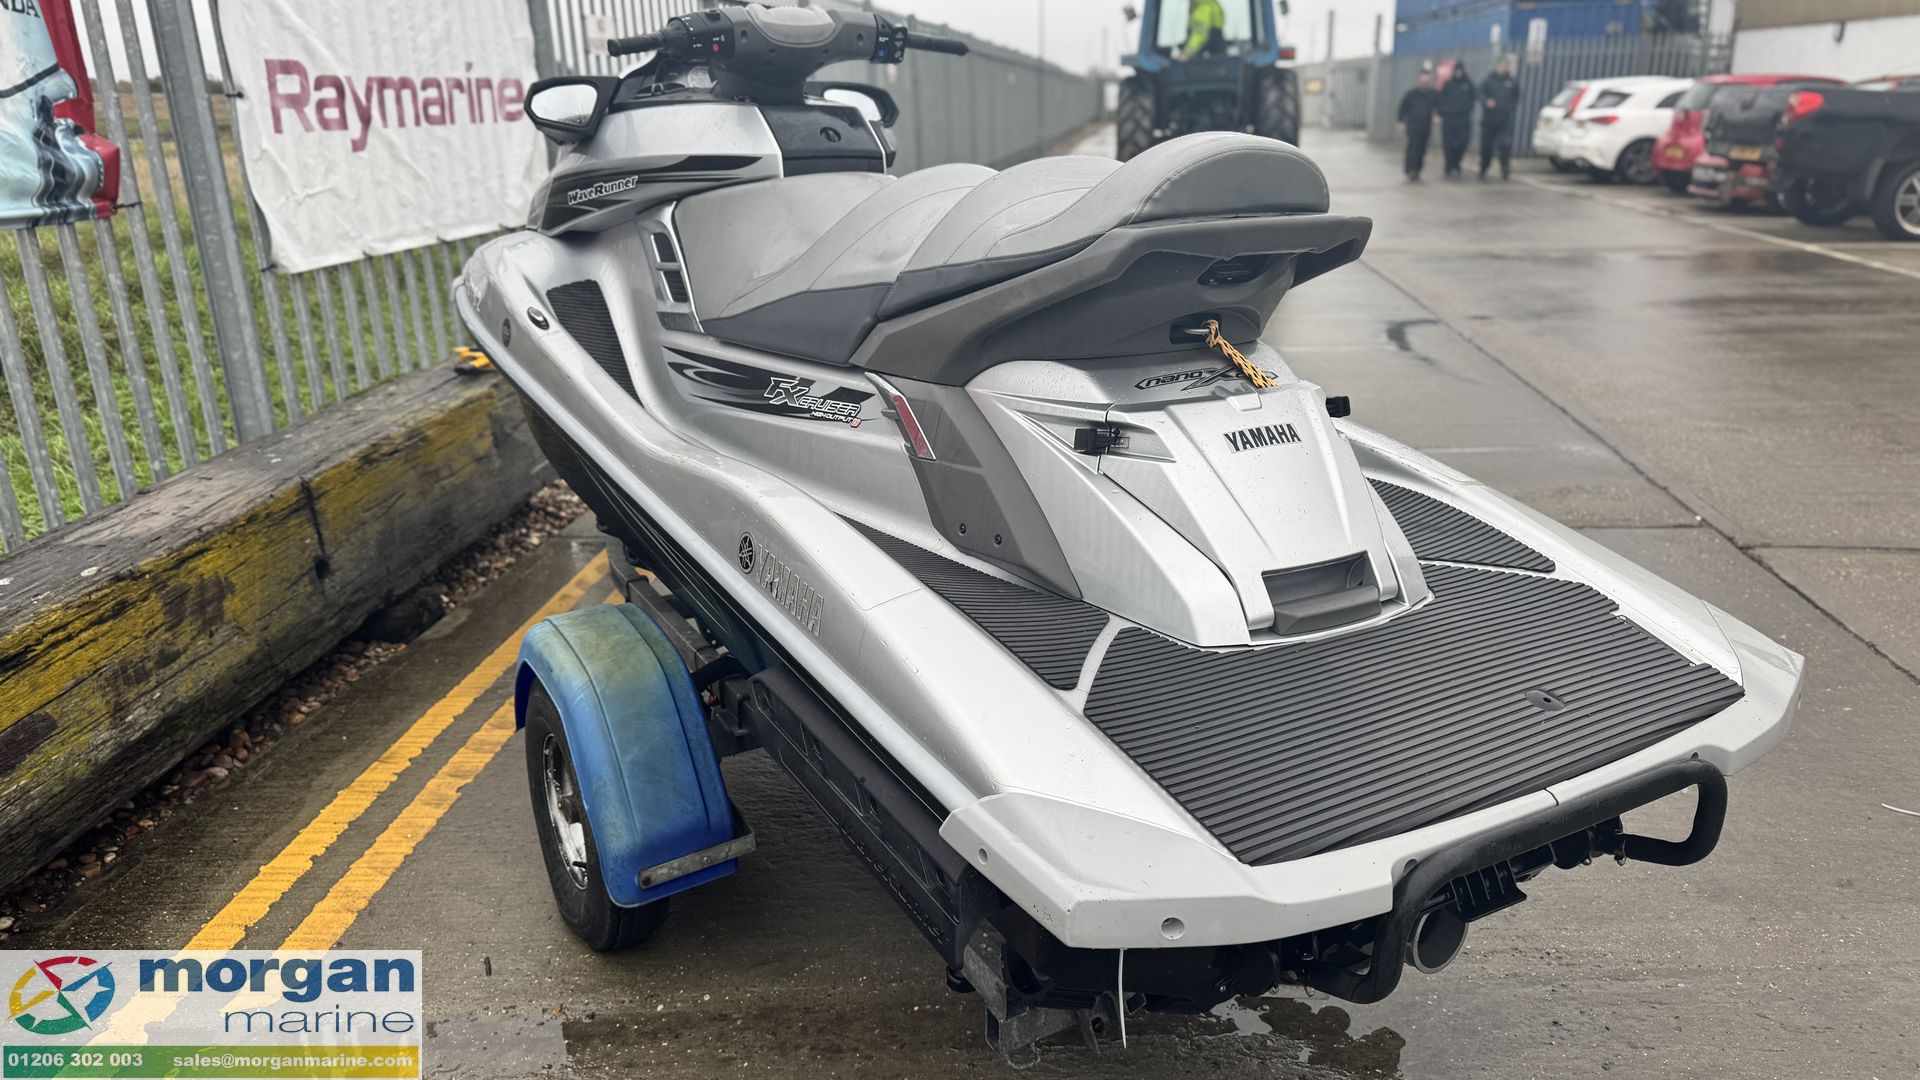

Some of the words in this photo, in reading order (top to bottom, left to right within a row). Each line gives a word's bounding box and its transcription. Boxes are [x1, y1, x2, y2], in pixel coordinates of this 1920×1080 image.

[264, 58, 525, 153] Raymarine
[568, 175, 639, 205] WaveRunner
[763, 376, 810, 407] FX
[1223, 423, 1302, 452] YAMAHA
[756, 543, 825, 638] YAMAHA
